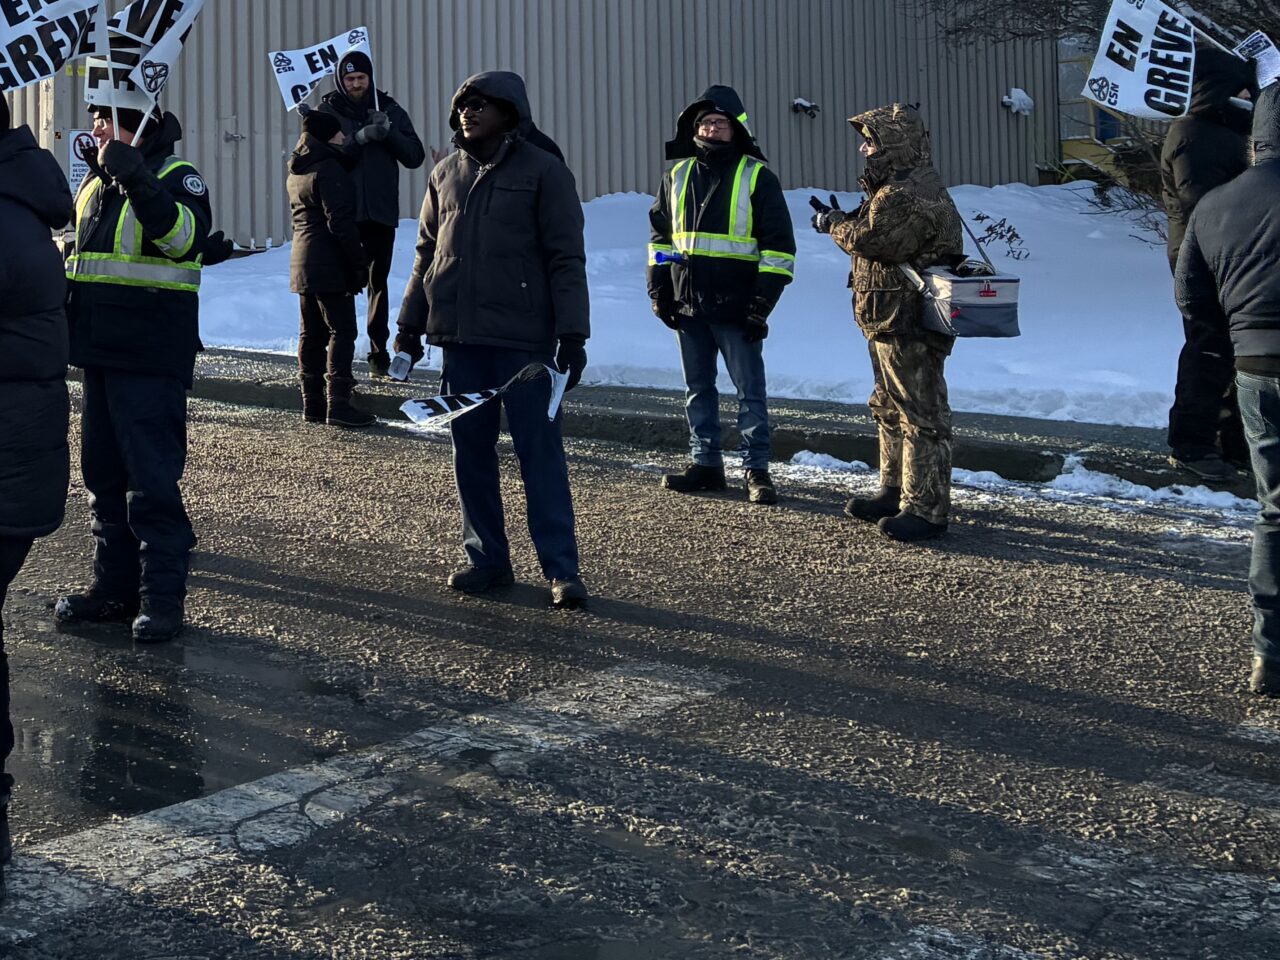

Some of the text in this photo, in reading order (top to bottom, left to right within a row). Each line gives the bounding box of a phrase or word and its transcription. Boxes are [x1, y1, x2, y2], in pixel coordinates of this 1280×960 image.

[304, 44, 339, 74] EN
[1105, 18, 1144, 73] EN
[276, 66, 295, 74] CSN
[1143, 10, 1193, 117] GRÈVE
[1108, 82, 1120, 106] CSN
